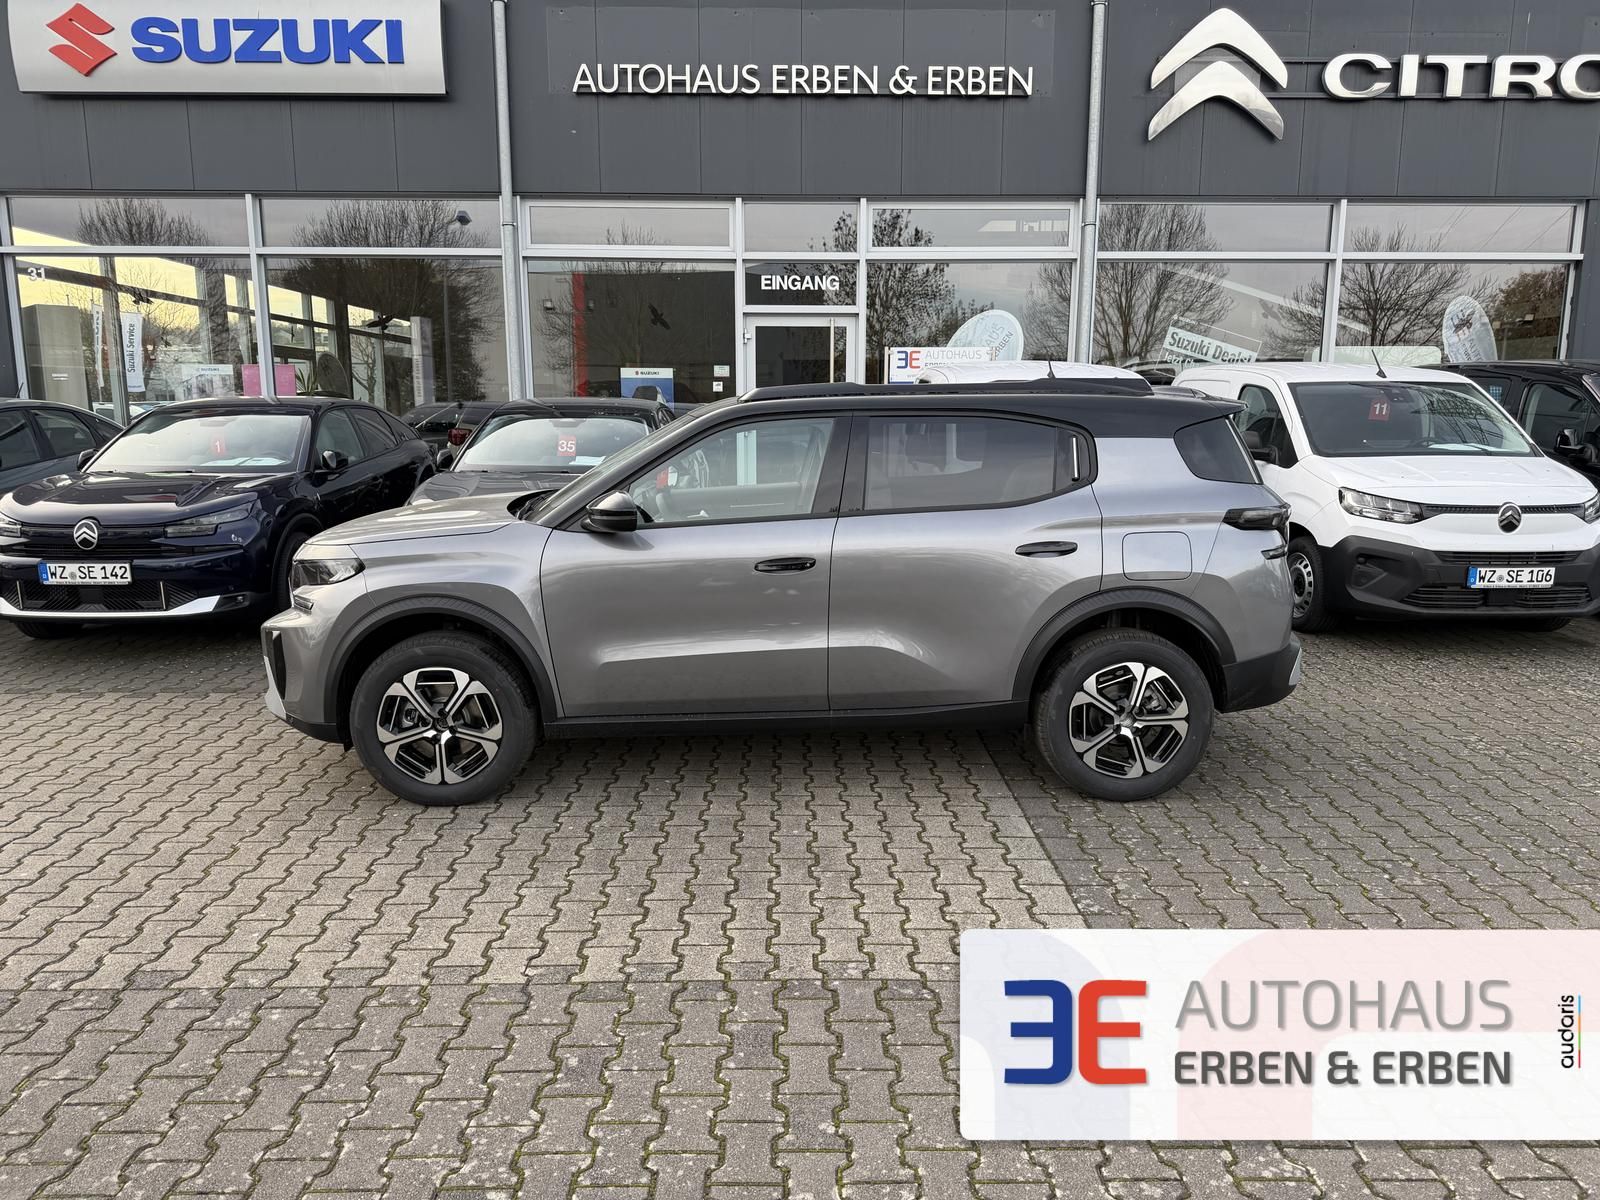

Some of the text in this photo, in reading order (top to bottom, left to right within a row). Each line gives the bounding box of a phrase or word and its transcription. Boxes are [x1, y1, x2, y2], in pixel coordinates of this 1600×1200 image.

[131, 16, 404, 65] SUZUKI
[572, 63, 1035, 97] AUTOHAUS ERBEN & ERBEN
[28, 267, 46, 281] 31
[760, 274, 840, 291] EINGANG
[126, 323, 135, 373] Suzuki Service
[1168, 331, 1212, 357] Suzuki
[924, 350, 982, 360] AUTOHAUS
[1373, 402, 1387, 415] 11
[215, 439, 221, 453] 1
[558, 439, 575, 452] 35
[48, 565, 68, 580] WZ
[78, 565, 97, 580] SE
[100, 565, 129, 580] 142
[1478, 569, 1496, 583] WZ
[1506, 569, 1525, 583] SE
[1527, 569, 1553, 583] 106
